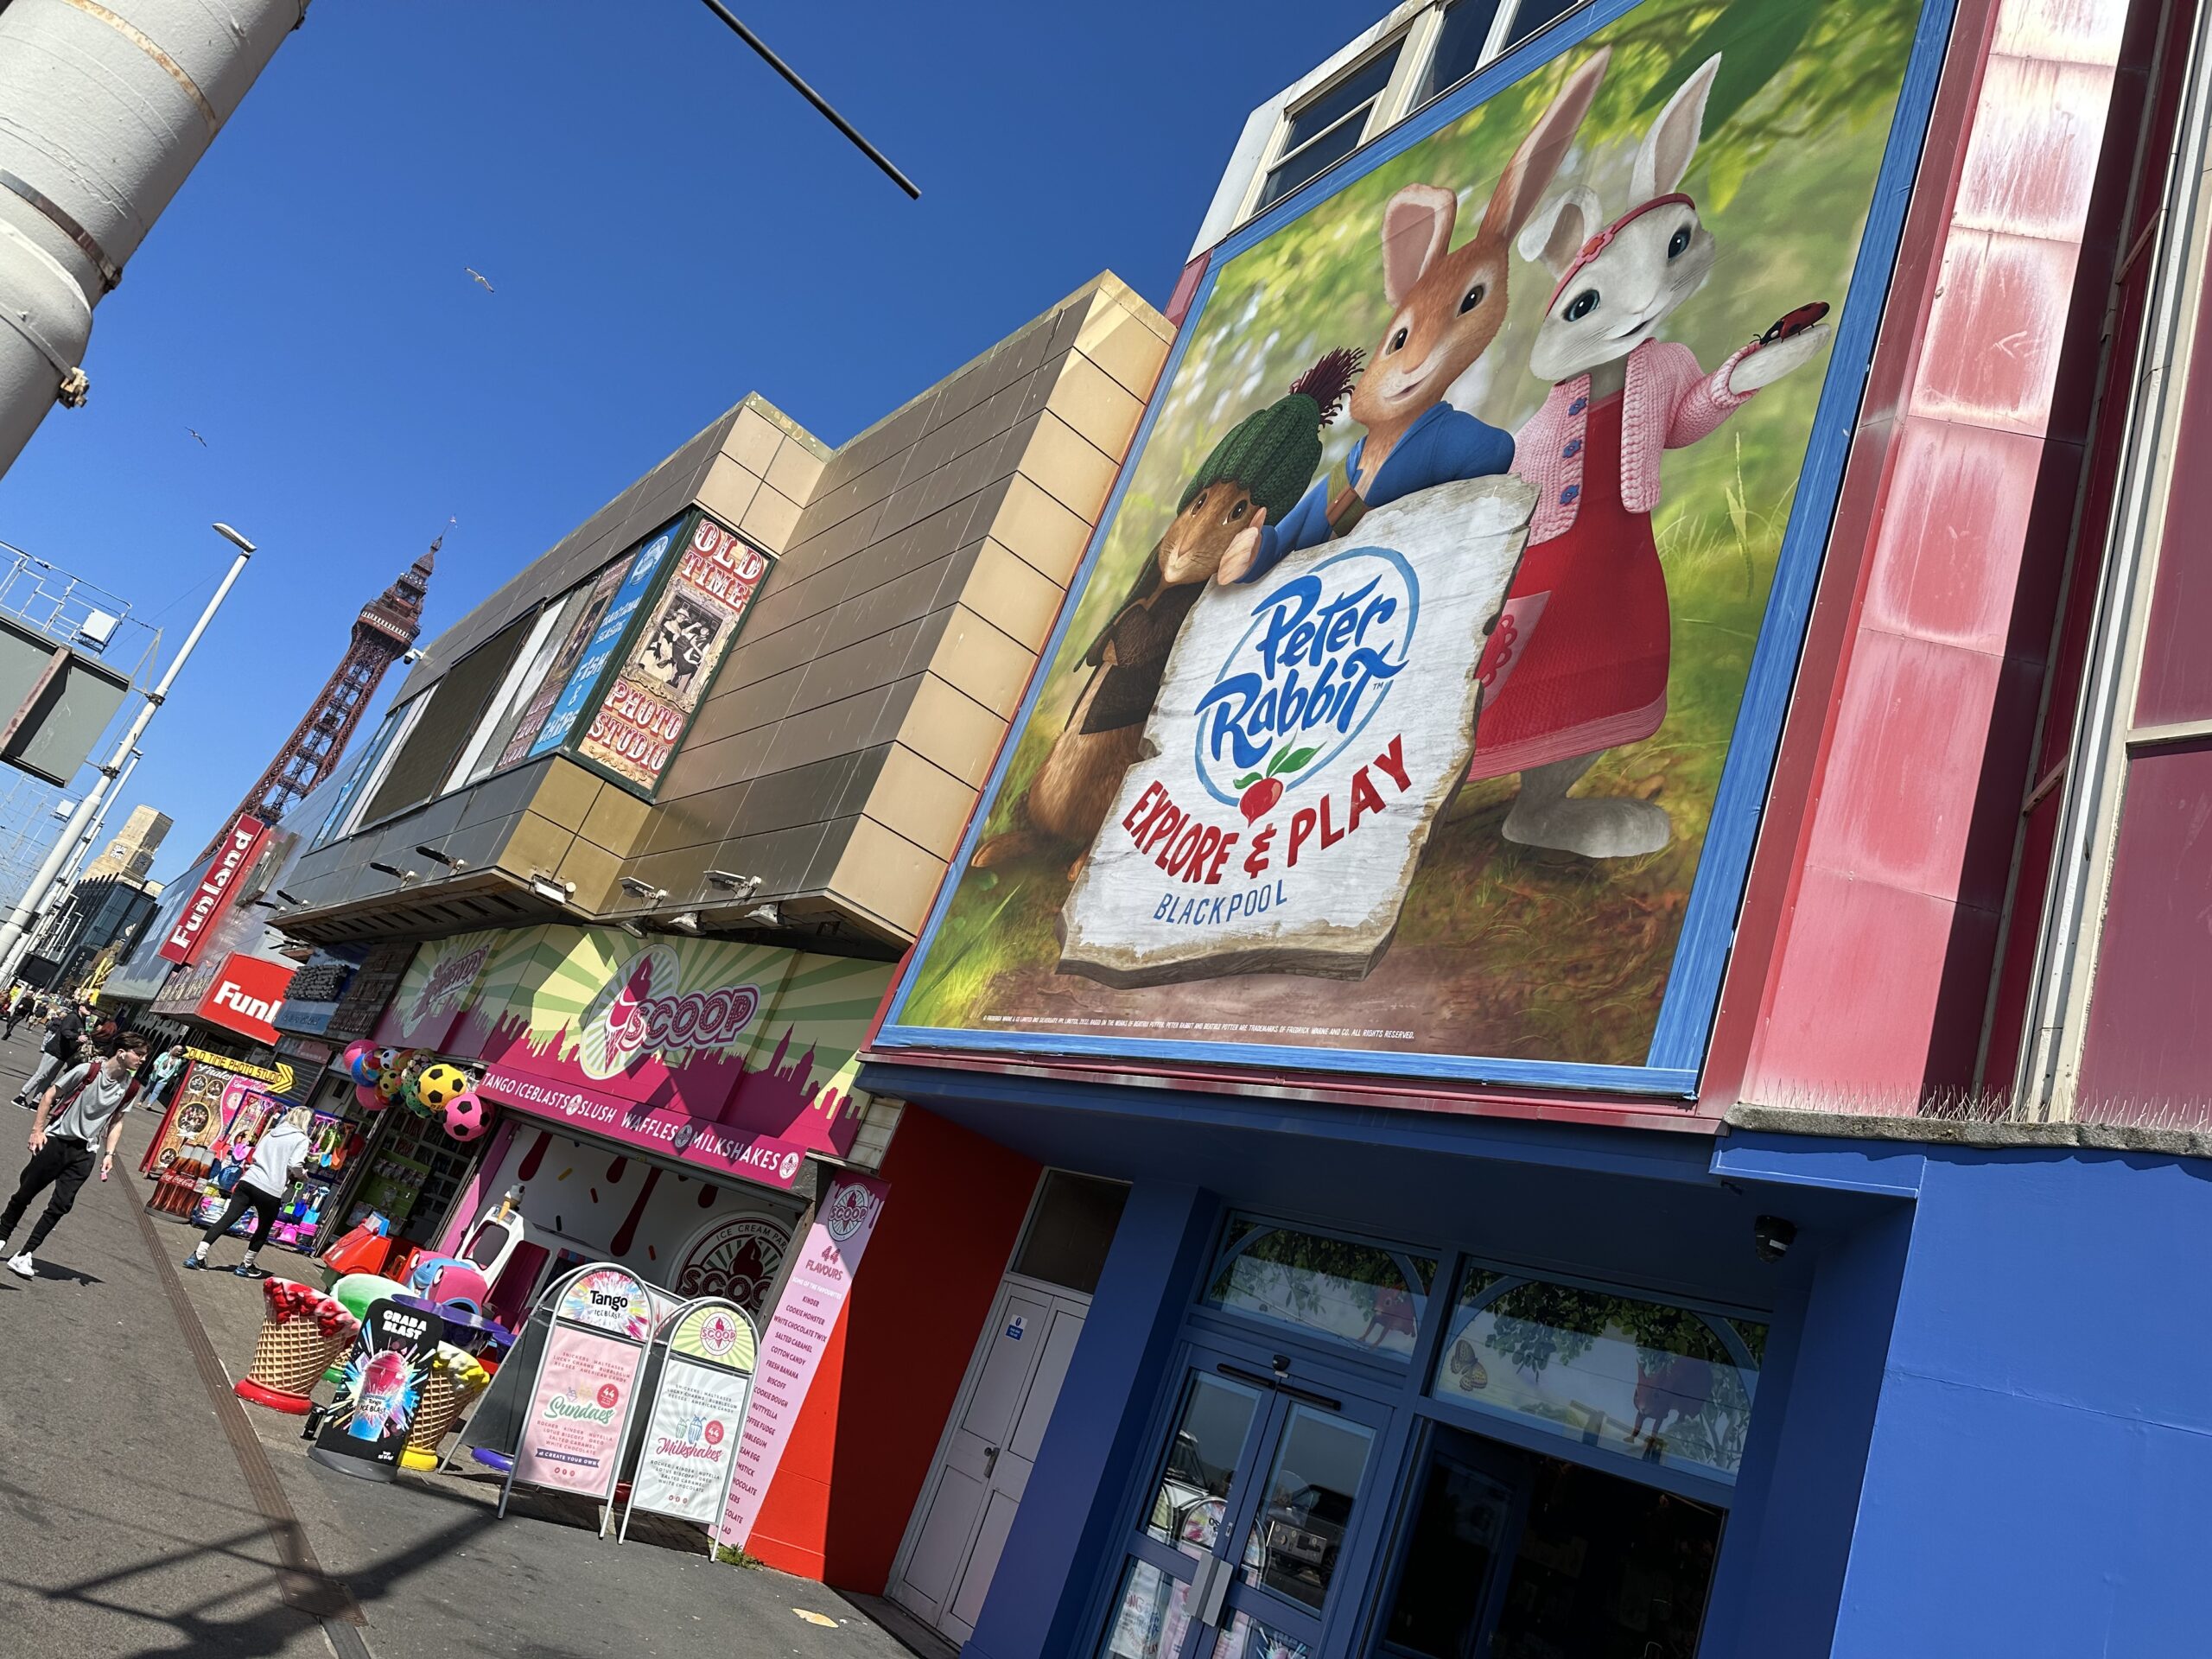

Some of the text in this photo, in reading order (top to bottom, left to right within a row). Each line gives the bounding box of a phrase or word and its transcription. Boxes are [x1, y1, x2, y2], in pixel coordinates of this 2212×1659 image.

[693, 521, 765, 587] OLD
[681, 550, 750, 613] TIME
[1251, 575, 1396, 679] Peter
[603, 679, 683, 745] PHOTO
[1194, 640, 1409, 768] Rabbit
[587, 712, 669, 775] STUDIO
[1122, 734, 1412, 885] EXPLORE & PLAY
[169, 830, 254, 949] Funland
[1154, 880, 1287, 925] BLACKPOOL
[213, 981, 283, 1023] Funl
[619, 987, 757, 1049] SCOOP
[189, 1049, 282, 1083] OLD TIME PHOTO STUDIO
[481, 1072, 781, 1171] TANGO ICEBLASTS SLUSH WAFFLES MILKSHAKES
[830, 1207, 868, 1220] SCOOP
[716, 1230, 732, 1241] ICE
[738, 1225, 771, 1236] CREAM
[822, 1246, 841, 1264] 44
[805, 1260, 842, 1281] FLAVOURS
[590, 1290, 627, 1312] Tango
[802, 1296, 819, 1307] KINDER
[786, 1305, 825, 1325] COOKIE MONSTER
[383, 1320, 422, 1339] BLAST
[700, 1327, 736, 1341] SCOOP
[774, 1315, 828, 1342] WHITE CHOCOLATE TWIX
[775, 1332, 812, 1352] SALTED CARAMEL
[771, 1345, 806, 1366] COTTON CANDY
[766, 1360, 798, 1379] FRESH BANANA
[767, 1376, 786, 1389] BISCOFF
[603, 1388, 614, 1399] 44
[753, 1387, 788, 1408] COOKIE DOUGH
[544, 1396, 614, 1424] Sundaes
[752, 1402, 778, 1420] NUTTYELLA
[709, 1427, 719, 1437] 44
[747, 1416, 775, 1435] OFFEE FUDGE
[657, 1438, 722, 1462] Milkshakes
[740, 1446, 760, 1462] EAM EGG
[737, 1462, 755, 1477] MSTICK
[733, 1478, 757, 1496] HOCOLATE
[725, 1509, 743, 1524] COLATE
[721, 1524, 731, 1535] LAD
